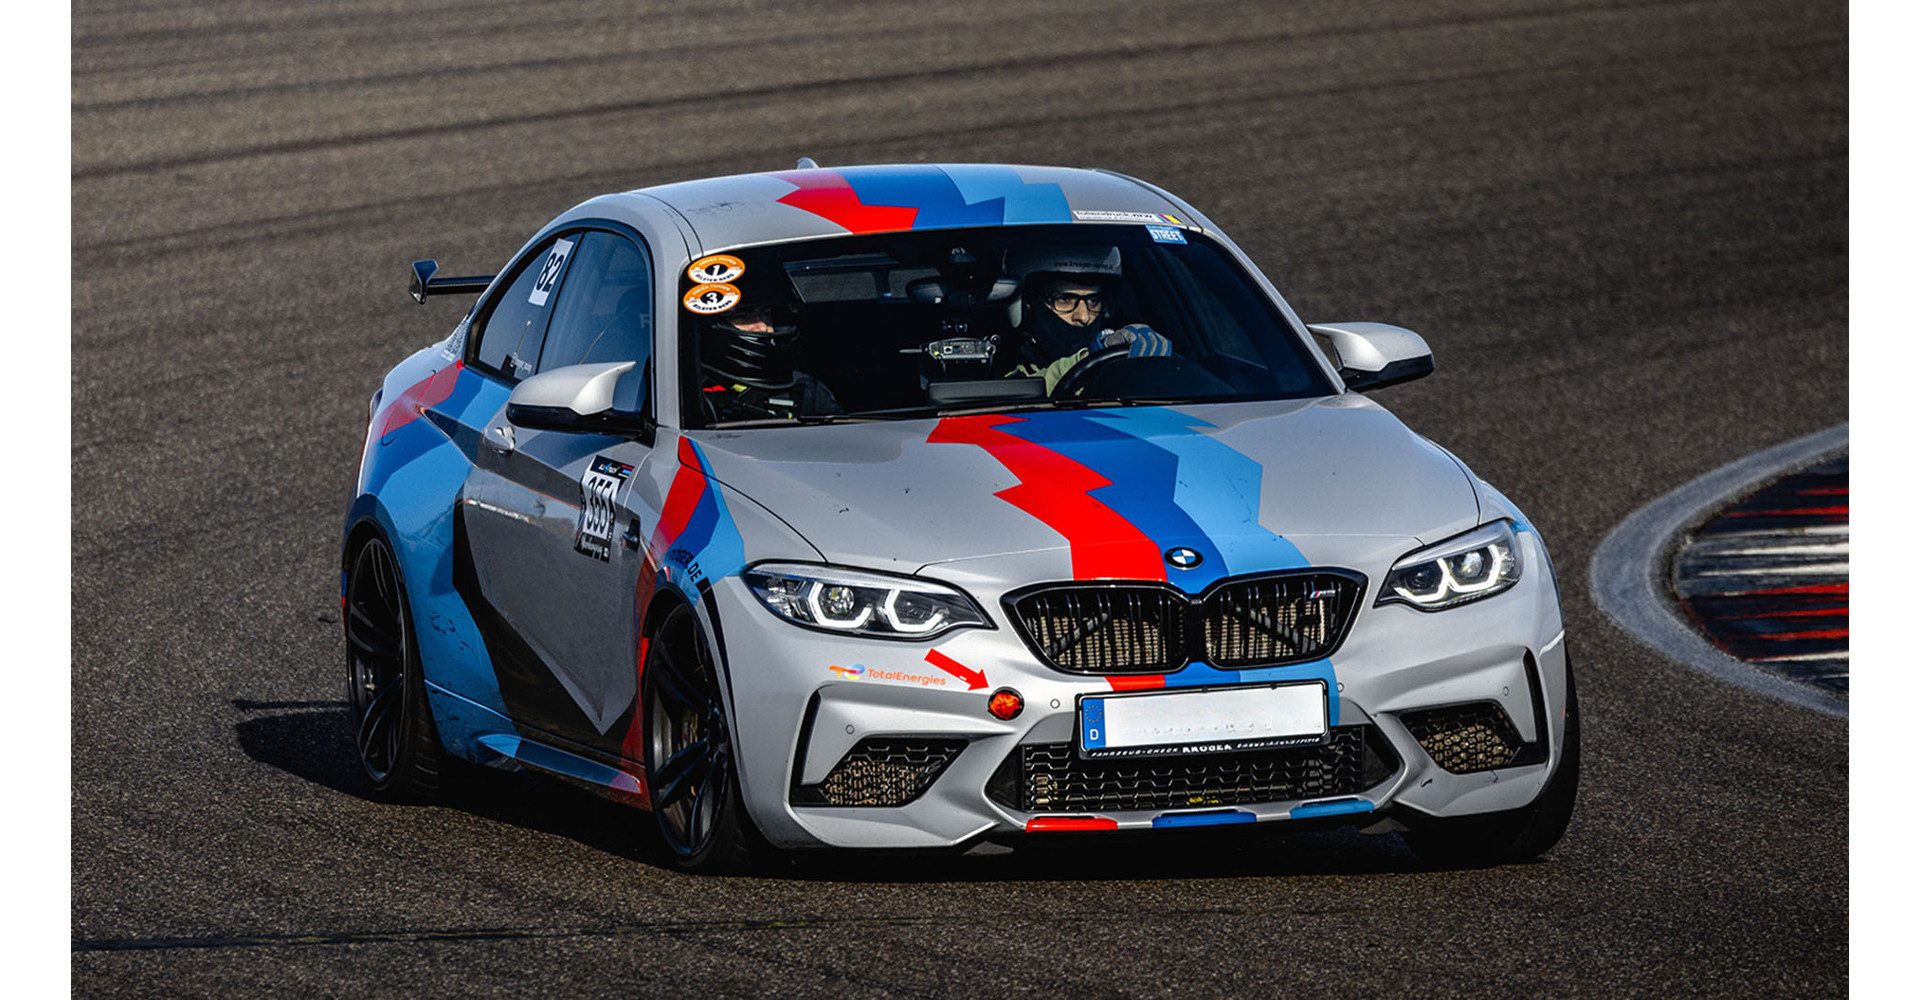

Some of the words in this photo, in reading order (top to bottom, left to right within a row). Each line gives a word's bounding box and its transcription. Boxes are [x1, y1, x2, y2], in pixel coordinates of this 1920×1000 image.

[1150, 229, 1183, 241] STREET
[536, 252, 565, 292] 82
[712, 264, 721, 276] 1
[706, 292, 718, 305] 3
[587, 475, 614, 535] 355
[867, 668, 947, 686] TotalEnergies
[1089, 728, 1099, 740] D
